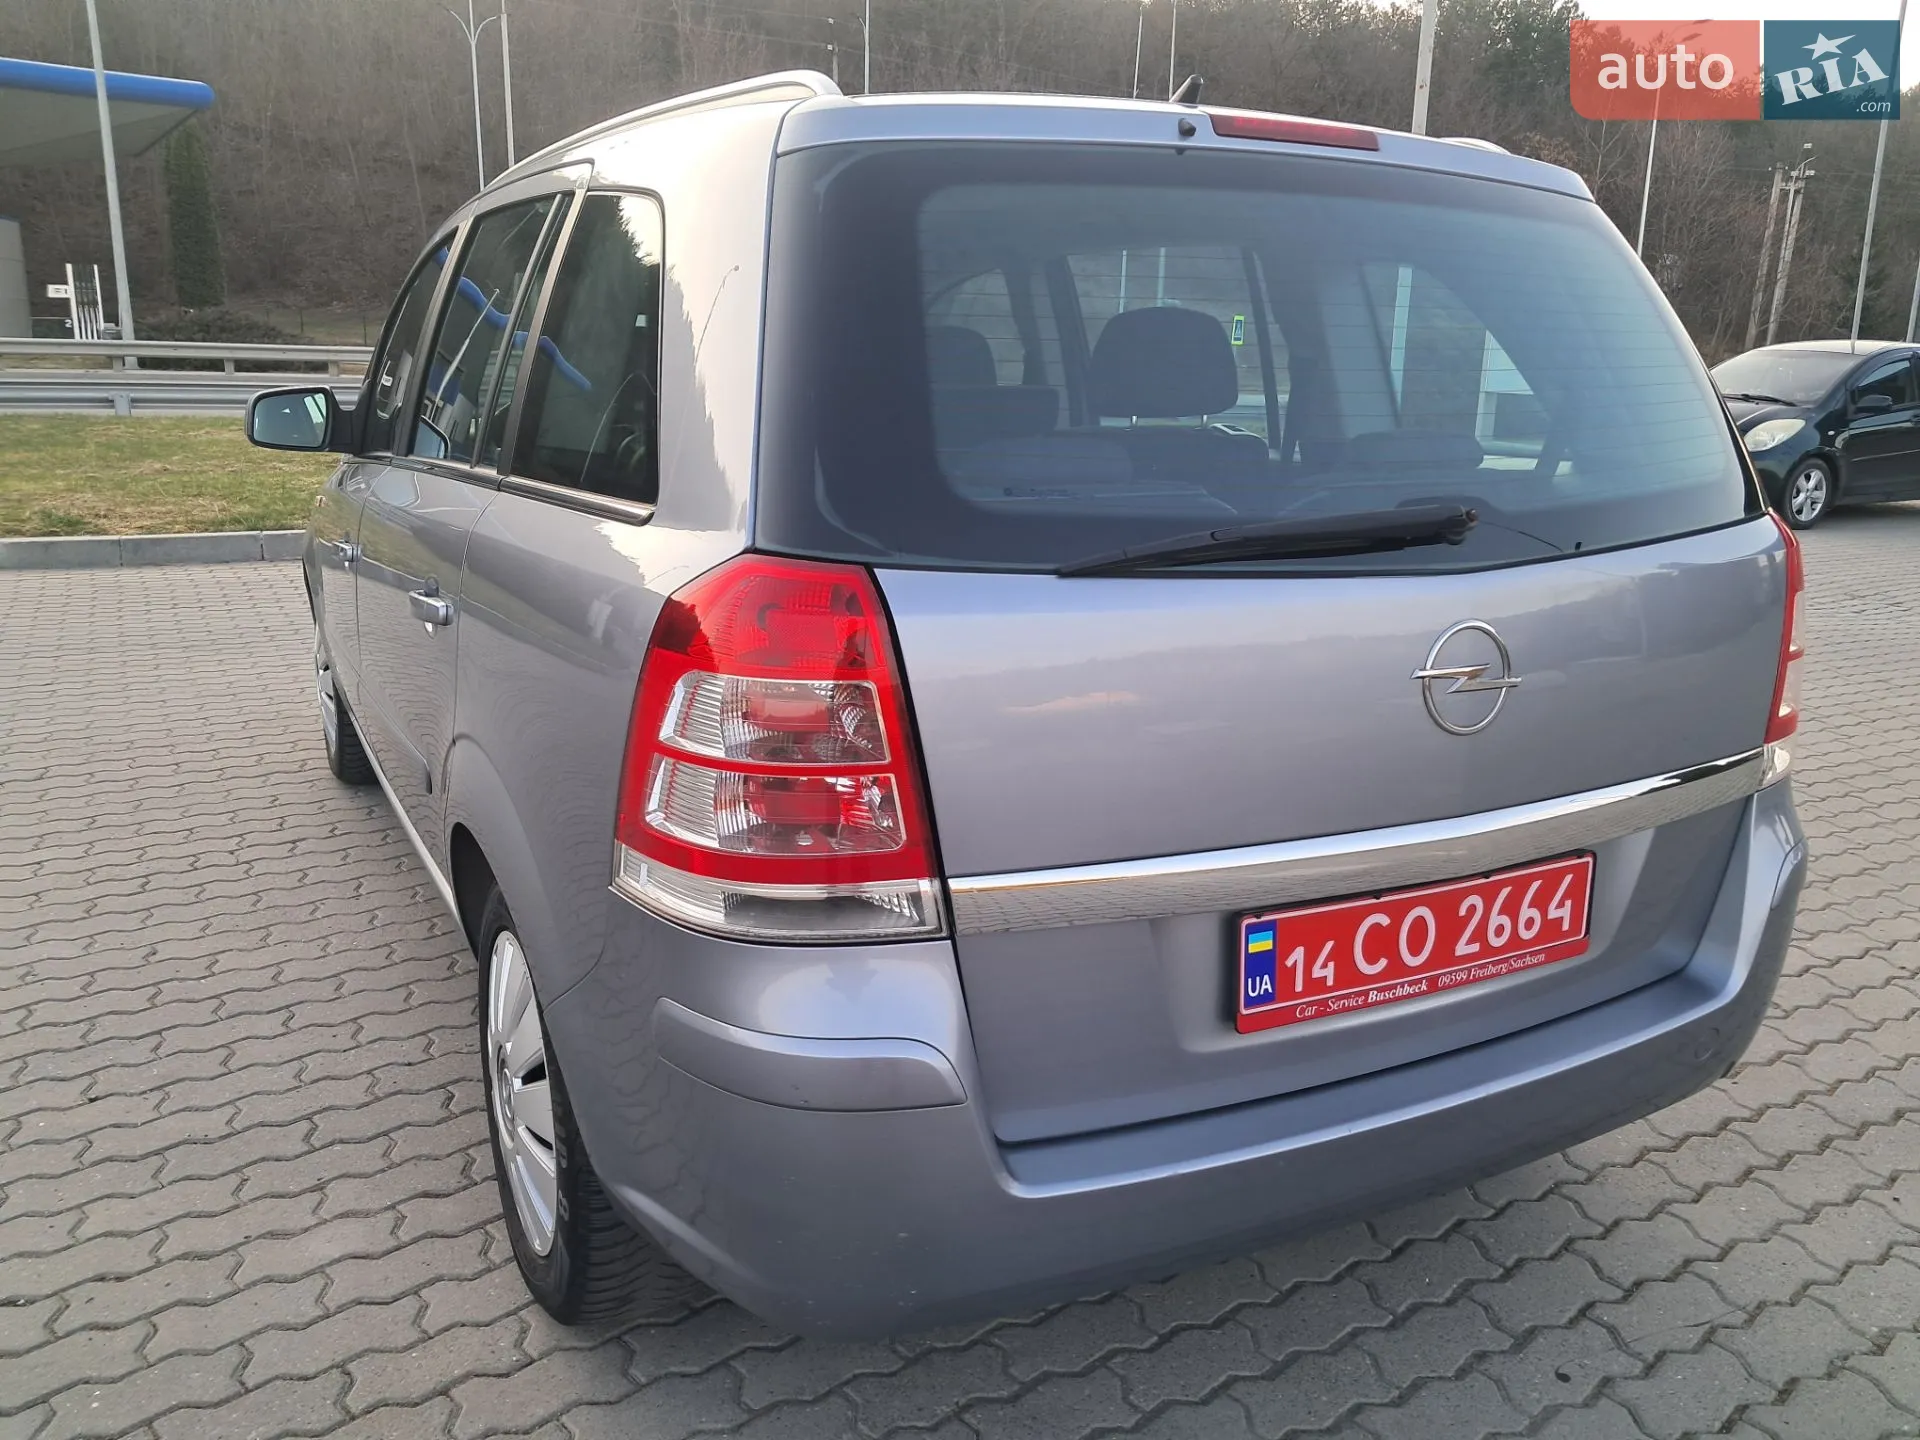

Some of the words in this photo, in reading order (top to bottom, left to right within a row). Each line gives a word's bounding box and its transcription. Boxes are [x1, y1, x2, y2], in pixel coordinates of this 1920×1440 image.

[1284, 940, 1336, 993] 14
[1353, 905, 1436, 975] CO
[1454, 873, 1575, 957] 2664
[1247, 974, 1273, 998] UA
[1296, 1005, 1317, 1019] Car
[1326, 995, 1365, 1012] Service
[1367, 979, 1429, 1003] Buschbeck
[1438, 970, 1469, 988] 09599
[1469, 953, 1546, 980] Freiberg/Sachsen
